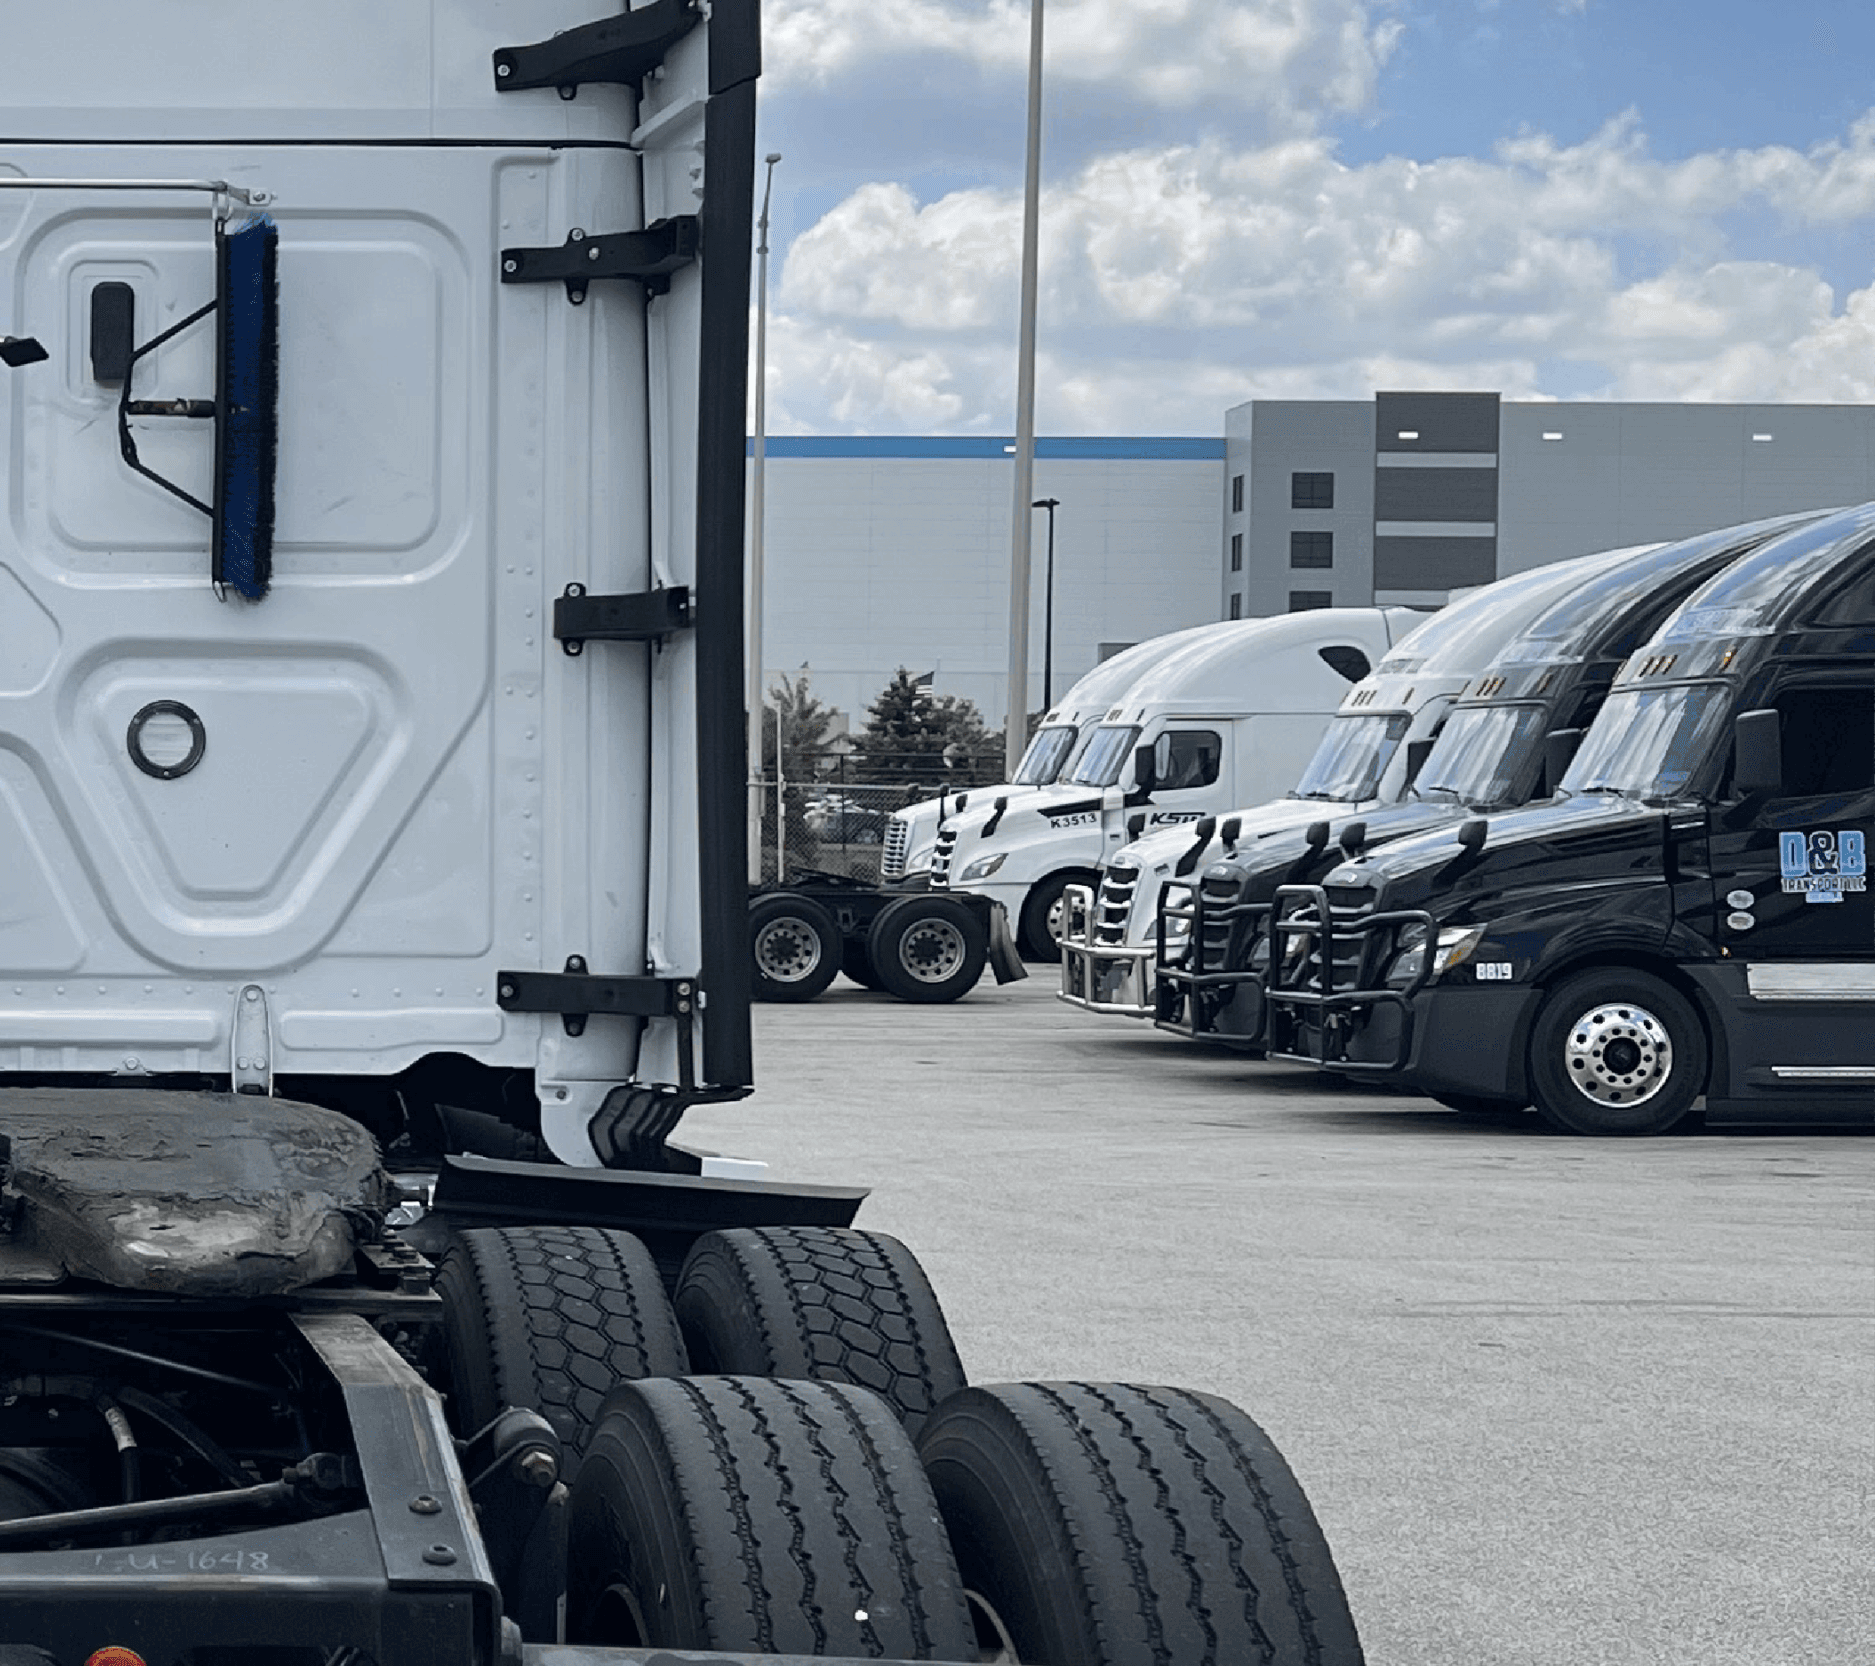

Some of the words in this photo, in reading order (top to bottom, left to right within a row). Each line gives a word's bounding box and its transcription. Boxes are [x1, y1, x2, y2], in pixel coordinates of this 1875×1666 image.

[1050, 813, 1097, 829] K3513
[1779, 831, 1866, 876] D&B
[1781, 877, 1844, 892] TRANSPORT
[1476, 963, 1512, 979] 8819
